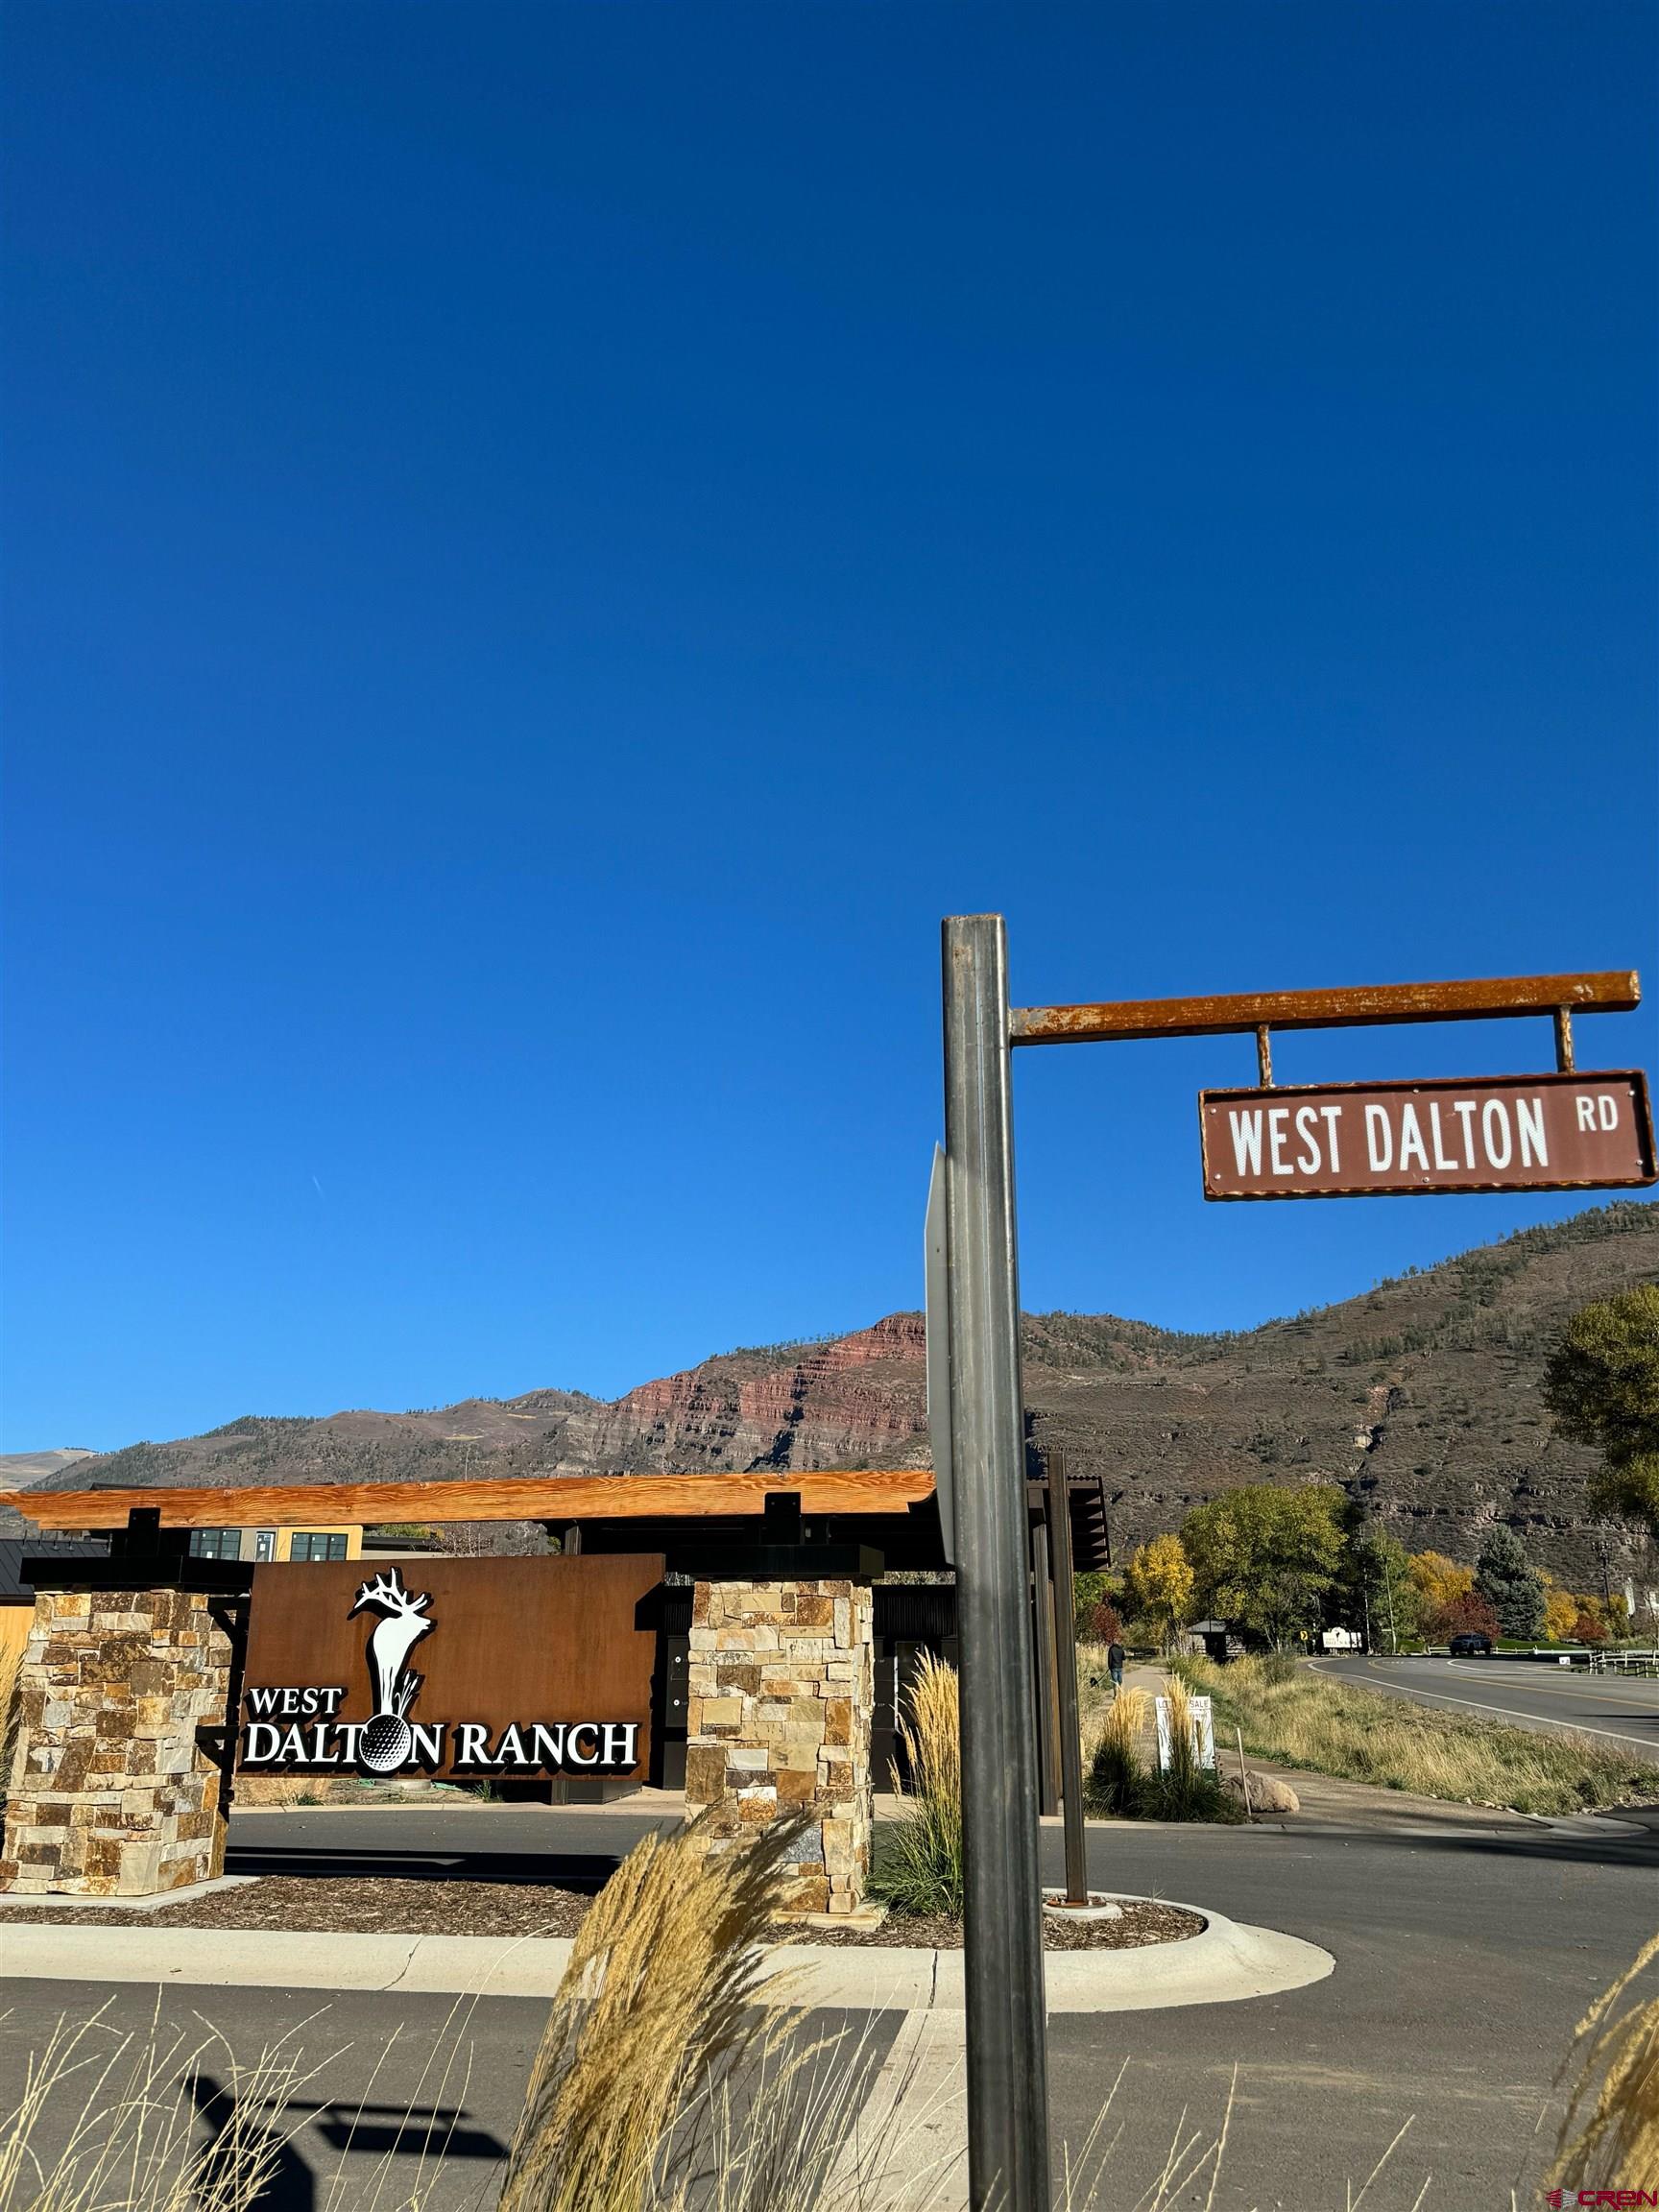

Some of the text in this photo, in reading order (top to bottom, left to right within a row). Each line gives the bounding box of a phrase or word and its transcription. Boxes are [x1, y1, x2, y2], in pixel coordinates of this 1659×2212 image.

[1229, 1095, 1619, 1176] WEST DALTON RD
[250, 1688, 342, 1714] WEST
[1190, 1699, 1209, 1708] SALE
[244, 1713, 637, 1771] DALTON RANCH
